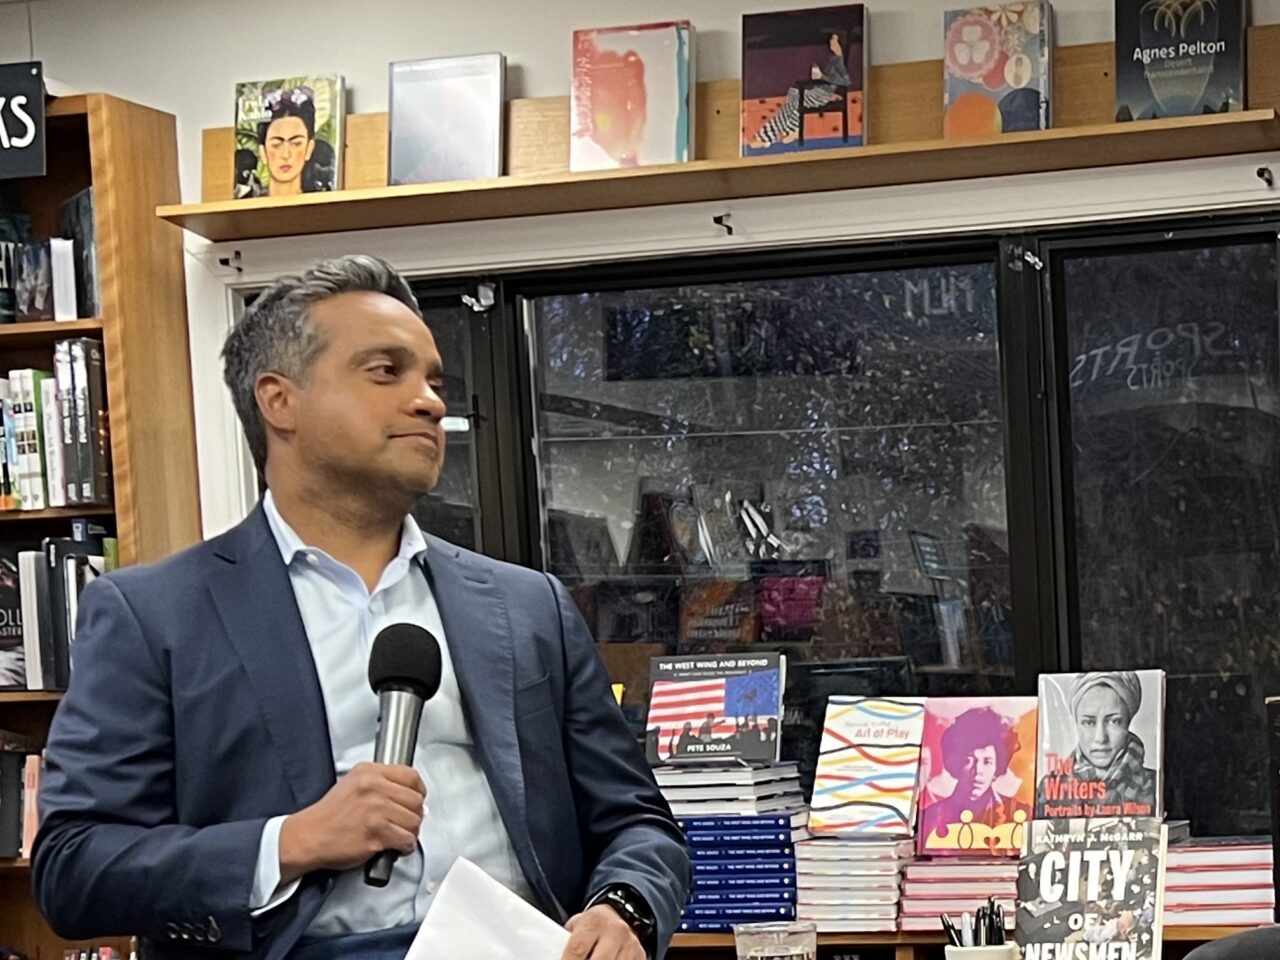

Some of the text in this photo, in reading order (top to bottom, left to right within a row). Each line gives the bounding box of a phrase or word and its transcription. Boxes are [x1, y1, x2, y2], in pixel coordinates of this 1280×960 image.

[1133, 39, 1225, 64] Agnes Pelton
[674, 661, 695, 670] WEST
[696, 660, 718, 669] WING
[719, 660, 736, 668] AND
[737, 658, 768, 667] BEYOND
[705, 743, 732, 752] SOUZA
[1045, 778, 1107, 800] Writers
[1044, 804, 1083, 816] Portraits
[1039, 850, 1135, 902] CITY
[1068, 912, 1099, 931] OF
